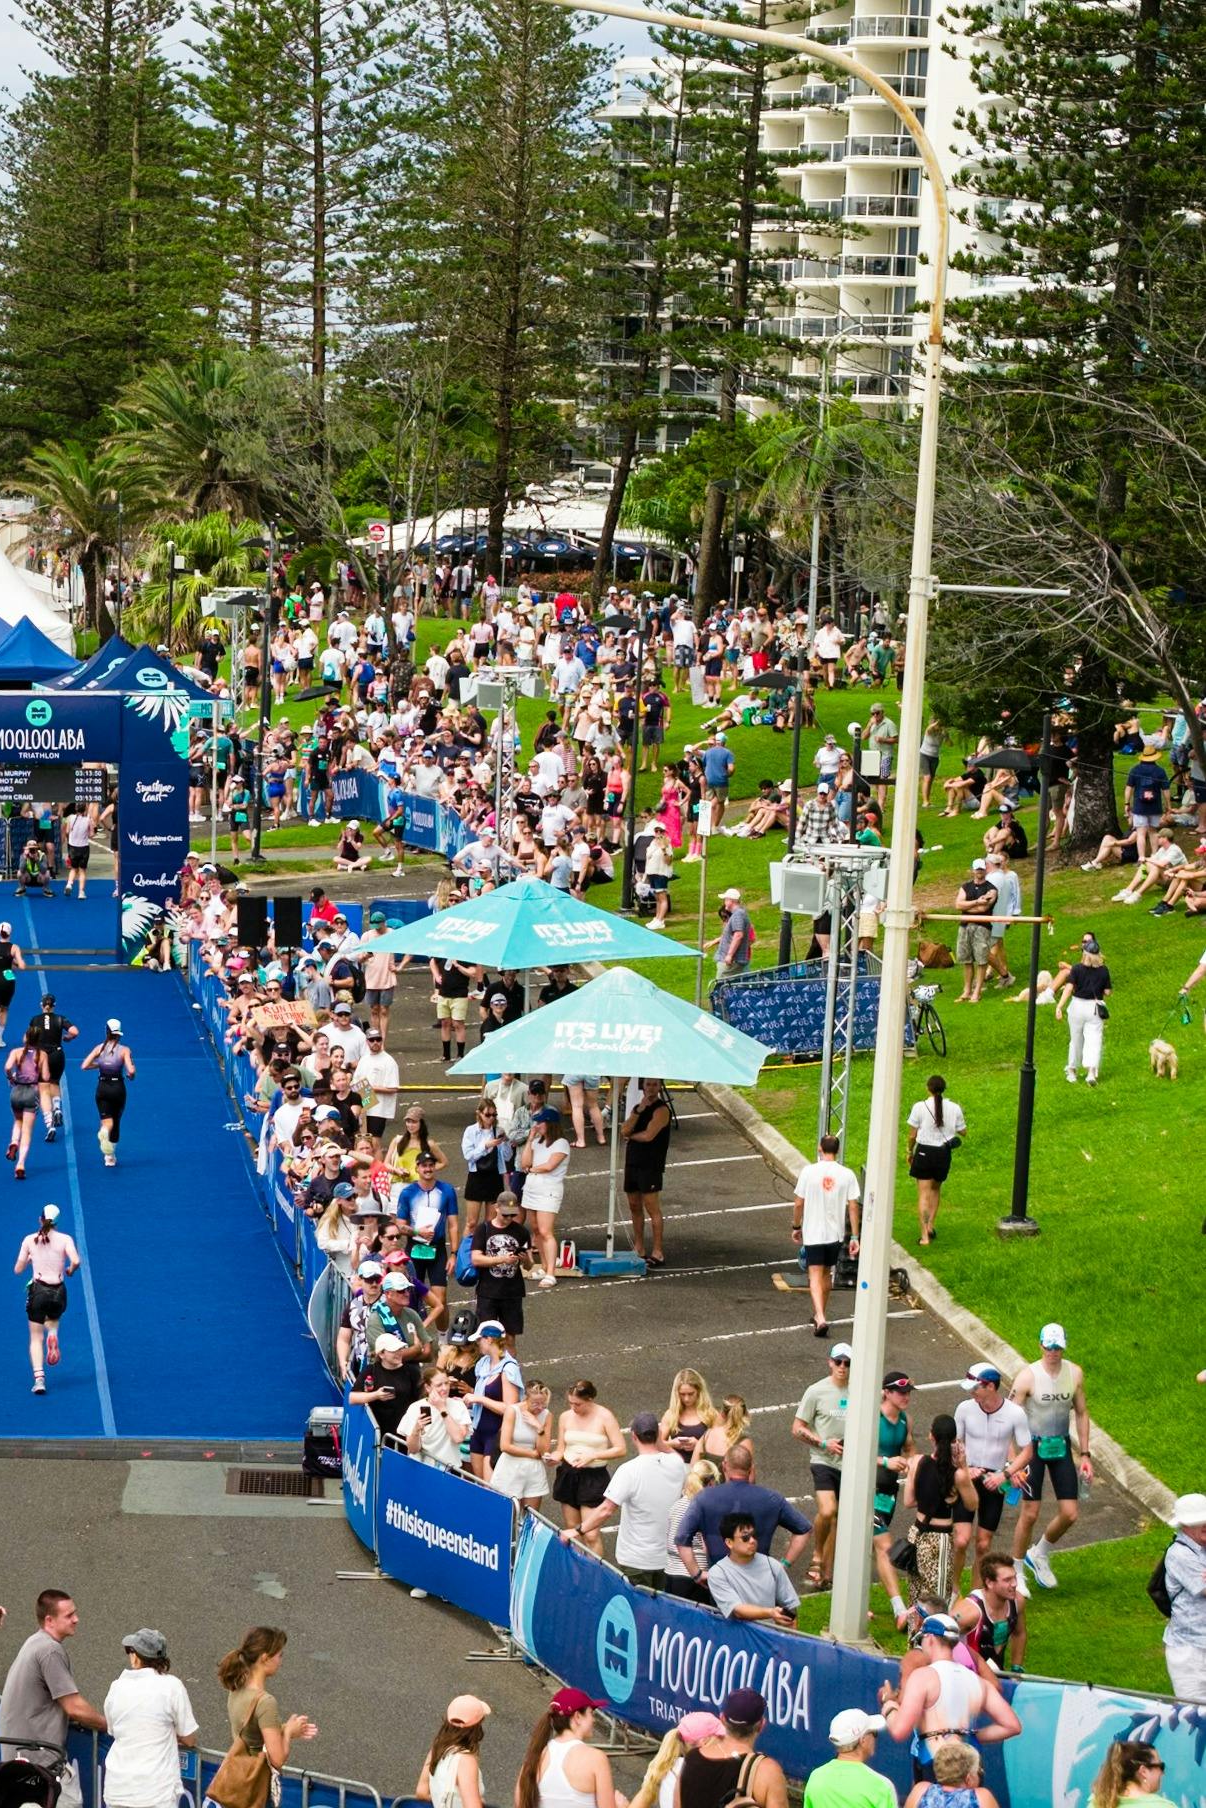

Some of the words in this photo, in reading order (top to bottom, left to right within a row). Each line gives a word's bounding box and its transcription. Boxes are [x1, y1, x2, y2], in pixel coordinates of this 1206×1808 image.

[133, 872, 178, 887] Queensland
[532, 924, 568, 937] IT'S
[564, 920, 613, 936] LIVE!
[554, 1022, 596, 1038] IT'S
[601, 1023, 663, 1041] LIVE!
[567, 1035, 654, 1054] Queensland
[1041, 1393, 1070, 1401] 2XU
[385, 1498, 499, 1572] #thisisqueensland
